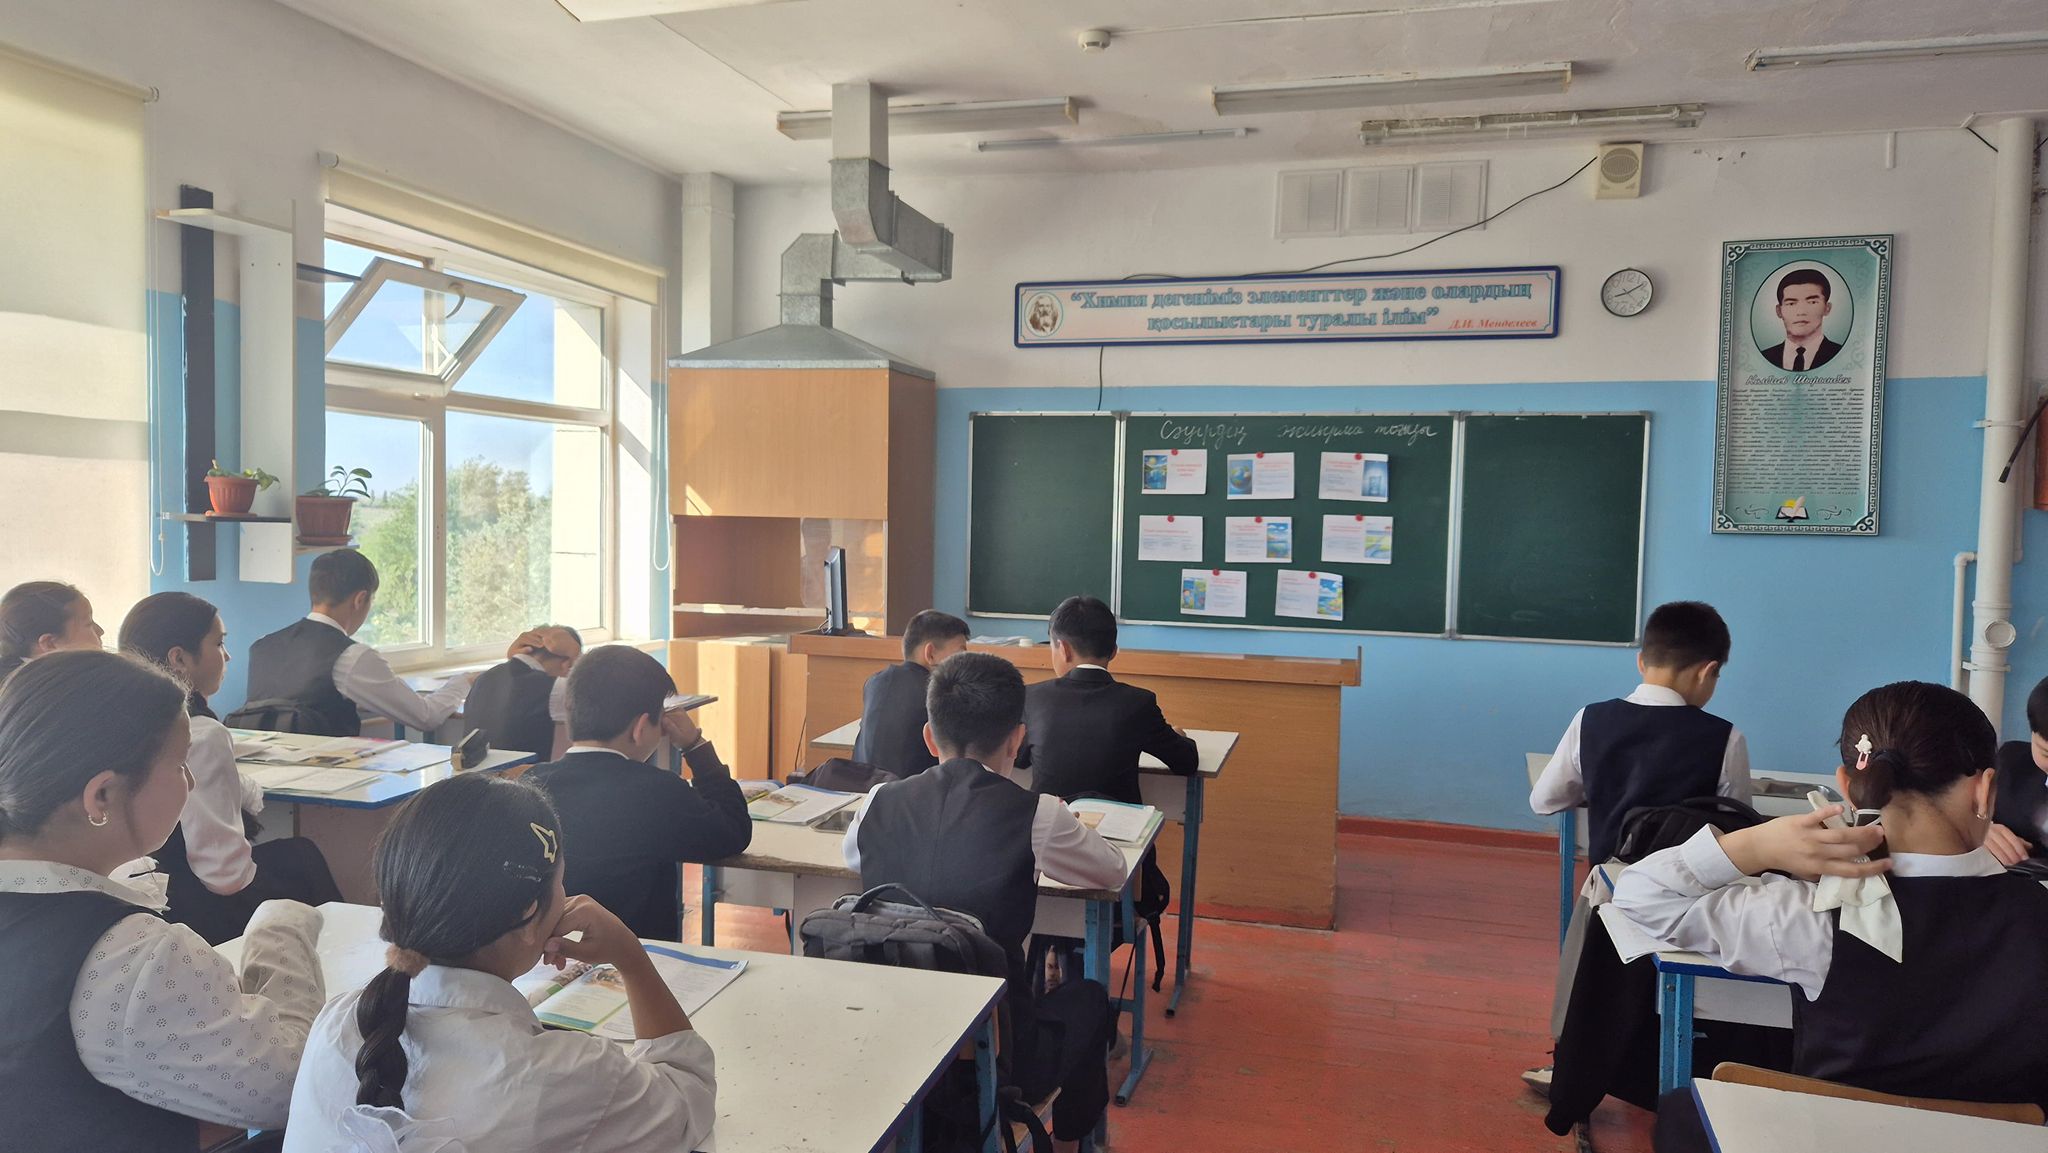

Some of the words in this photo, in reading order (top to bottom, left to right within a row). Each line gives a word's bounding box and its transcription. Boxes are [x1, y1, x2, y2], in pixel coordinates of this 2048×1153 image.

[1071, 291, 1147, 309] “Химия
[1151, 288, 1243, 308] дегеніміз
[1247, 286, 1367, 306] элементтер
[1371, 285, 1426, 302] және
[1431, 283, 1532, 303] олардың
[1147, 313, 1291, 333] қосылыстары
[1297, 311, 1377, 331] туралы
[1382, 306, 1440, 326] ілім”
[1448, 319, 1473, 329] Д.И.
[1479, 319, 1537, 329] Менделеев
